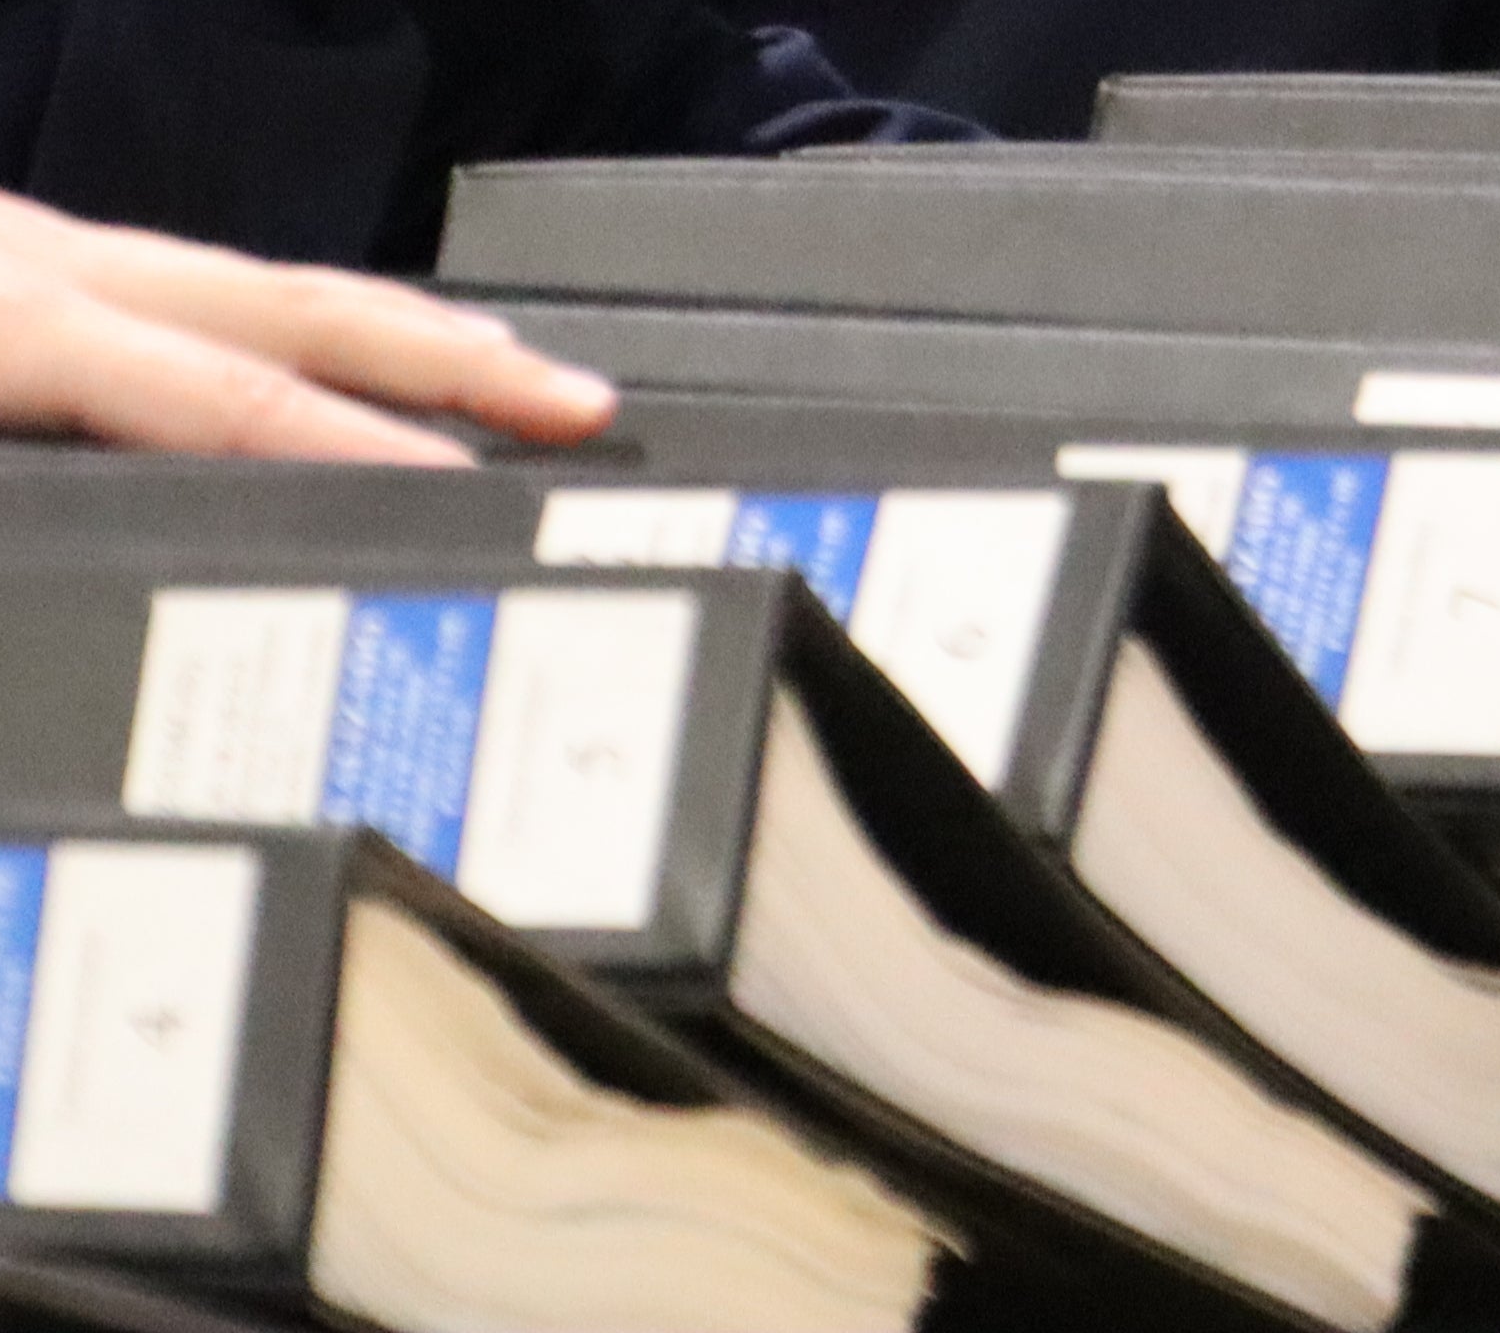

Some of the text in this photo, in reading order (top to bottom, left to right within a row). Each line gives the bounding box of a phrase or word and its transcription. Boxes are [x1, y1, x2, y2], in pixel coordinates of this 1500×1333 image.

[935, 619, 989, 661] 6
[563, 738, 626, 779] 5
[126, 1001, 183, 1055] 4
